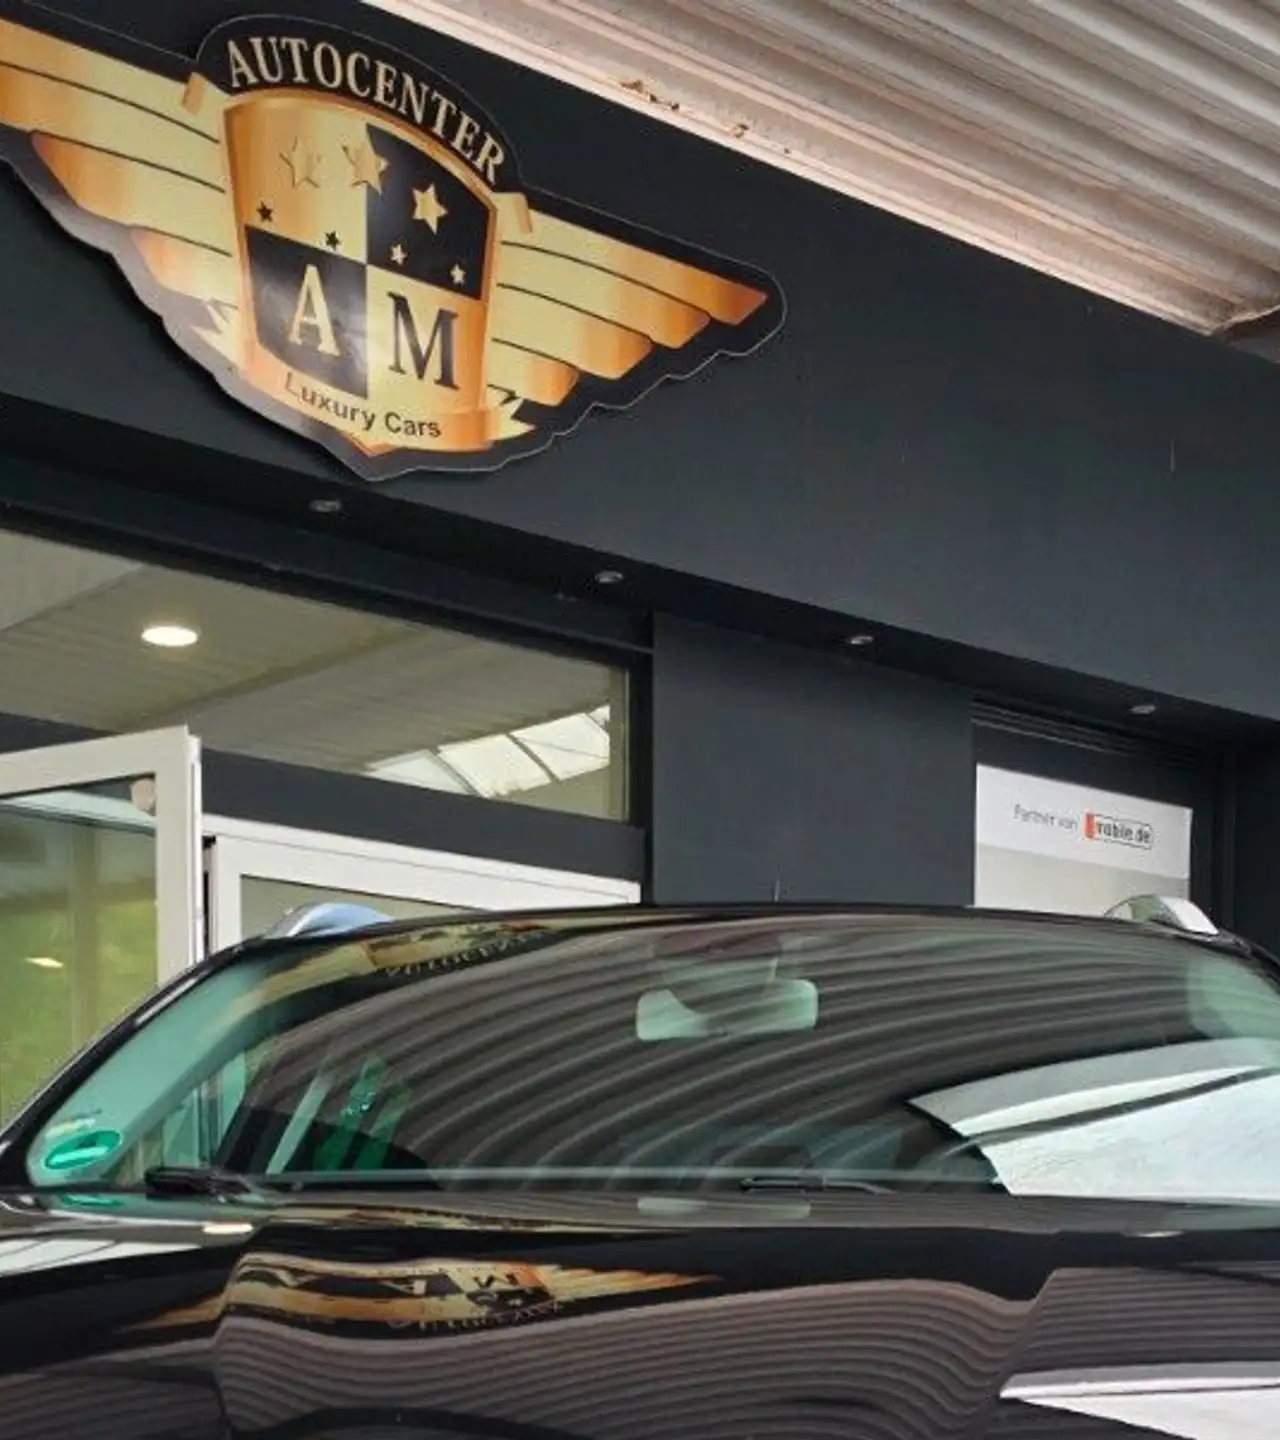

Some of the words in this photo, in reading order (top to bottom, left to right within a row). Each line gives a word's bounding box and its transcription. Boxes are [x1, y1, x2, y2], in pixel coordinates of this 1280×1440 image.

[227, 37, 505, 185] AUTOCENTER
[288, 264, 341, 356] A
[387, 291, 459, 390] M
[284, 371, 376, 432] Luxury
[384, 412, 442, 438] Cars
